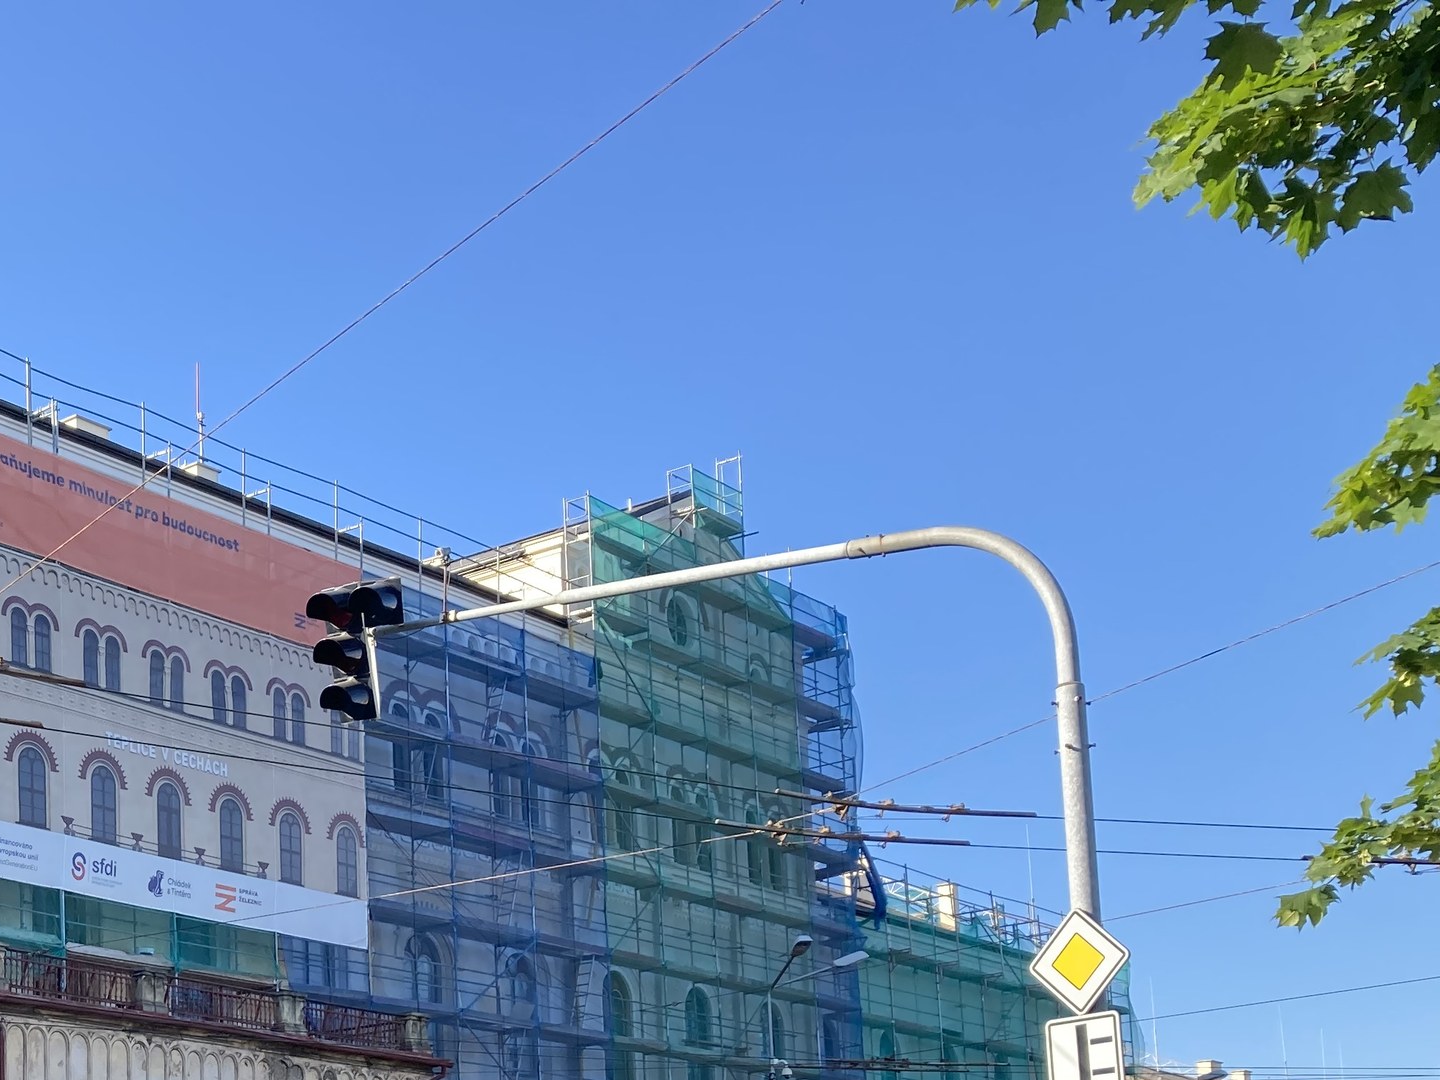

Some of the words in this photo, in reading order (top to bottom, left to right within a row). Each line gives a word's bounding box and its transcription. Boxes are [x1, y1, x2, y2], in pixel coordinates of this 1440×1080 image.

[69, 478, 132, 513] minulost
[135, 505, 159, 520] pro
[162, 511, 240, 551] budoucnost
[105, 731, 156, 760] TEPLICE
[162, 746, 171, 761] V
[92, 858, 117, 877] sfdi
[239, 888, 258, 897] SPRÁVA
